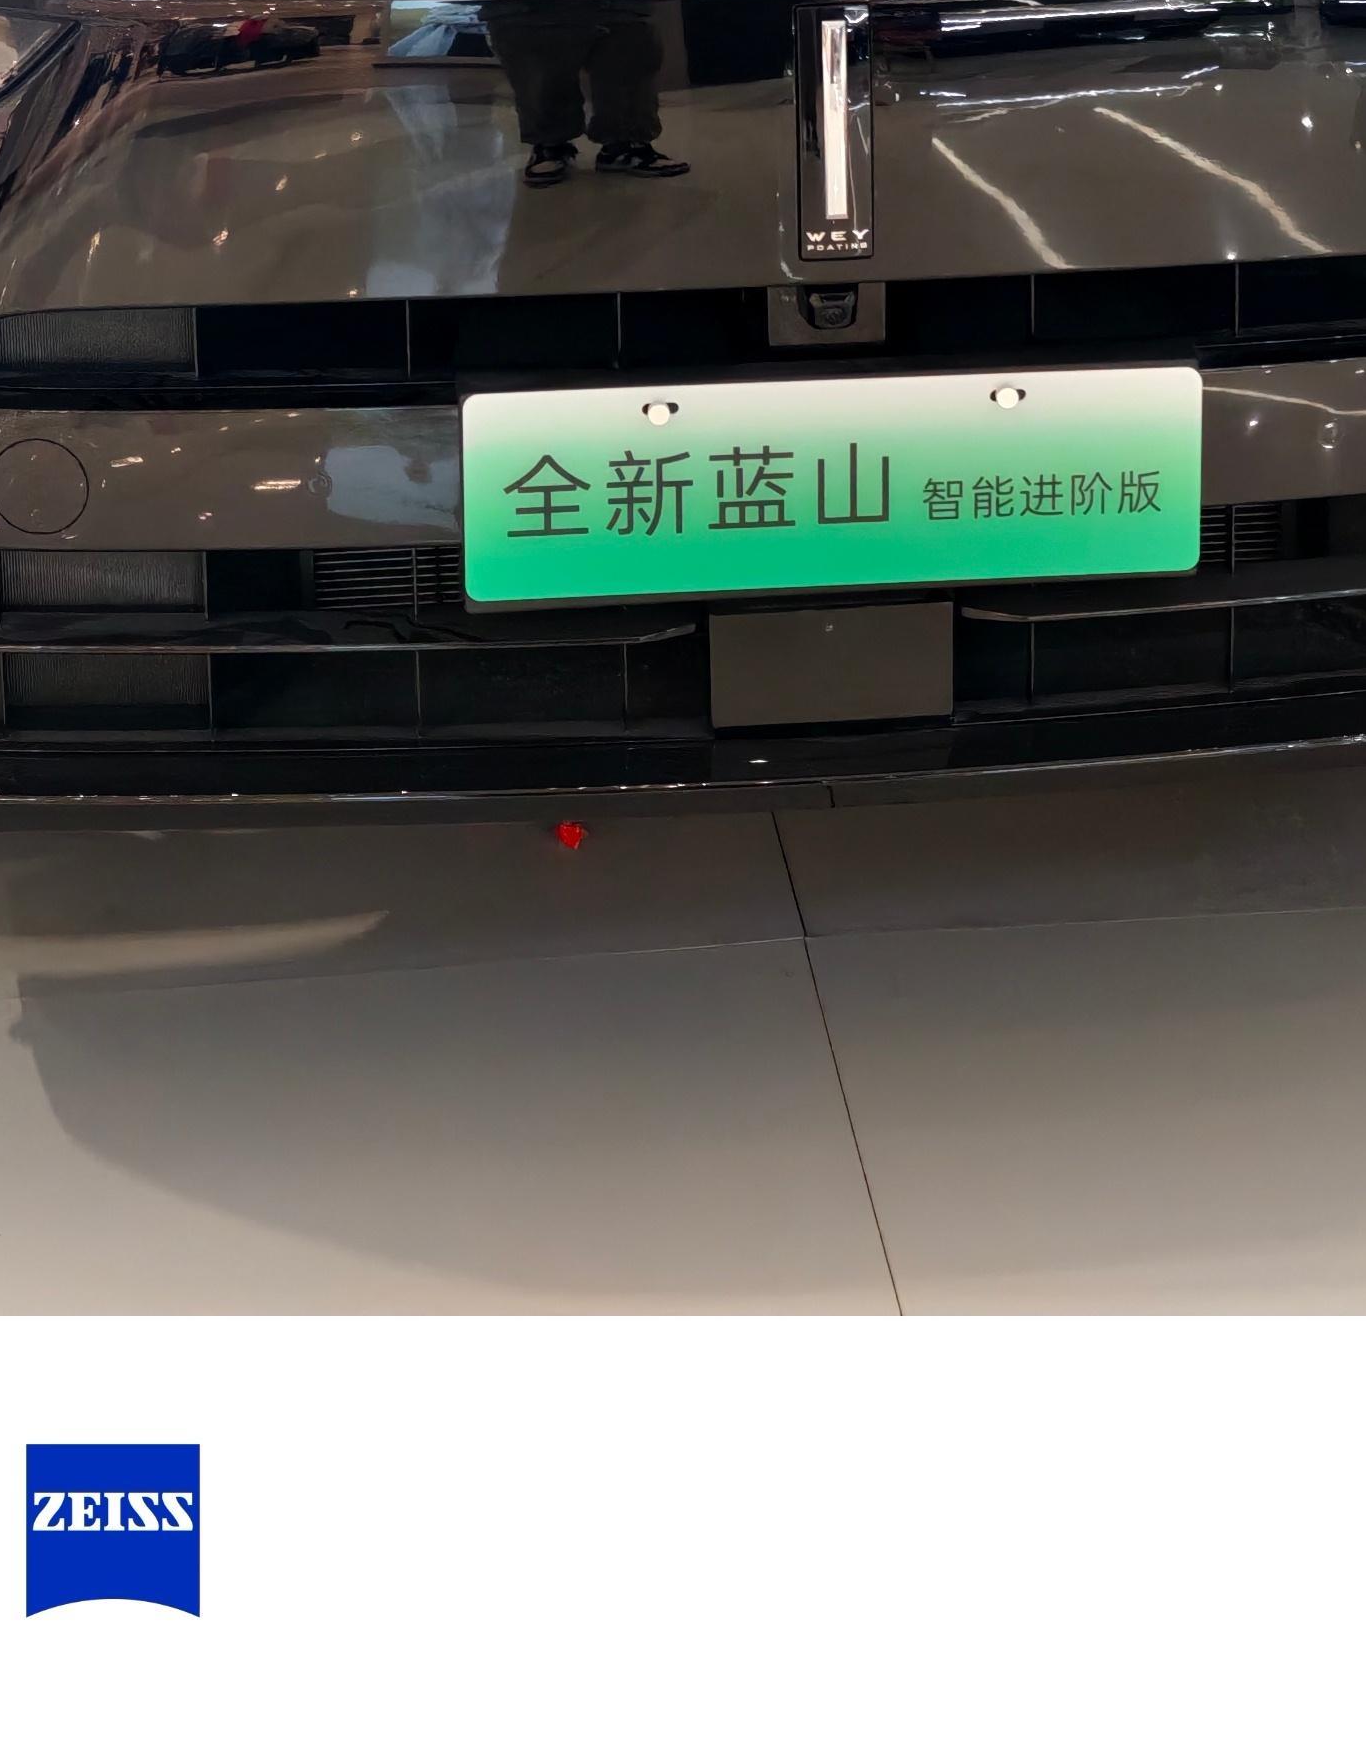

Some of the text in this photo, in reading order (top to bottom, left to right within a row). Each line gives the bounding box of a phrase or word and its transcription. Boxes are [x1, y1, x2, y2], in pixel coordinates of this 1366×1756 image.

[805, 228, 870, 243] WEY
[503, 442, 1162, 539] 全新蓝山 智能进阶版
